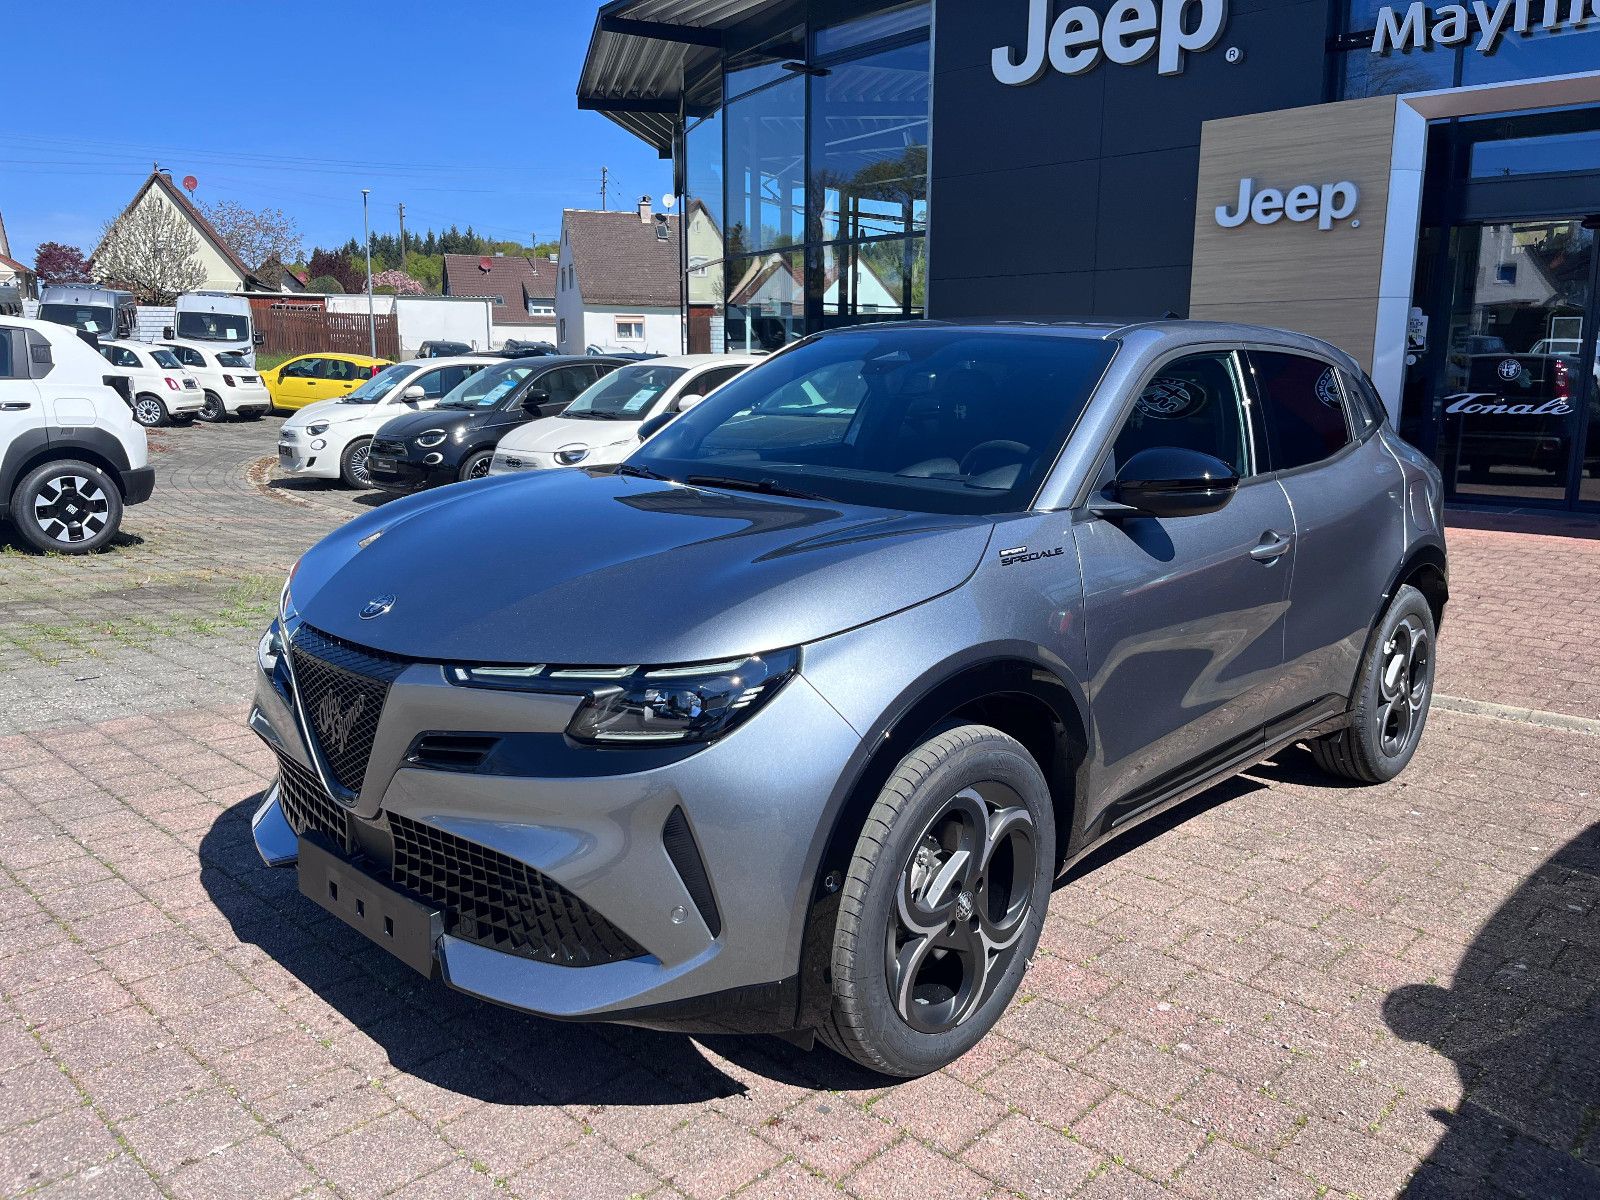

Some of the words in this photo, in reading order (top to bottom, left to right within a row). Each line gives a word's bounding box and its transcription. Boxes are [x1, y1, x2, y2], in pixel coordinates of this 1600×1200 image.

[991, 0, 1227, 86] Jeep
[1215, 178, 1358, 231] Jeep
[1443, 393, 1573, 415] Tonale
[1001, 547, 1064, 566] SPECIALE
